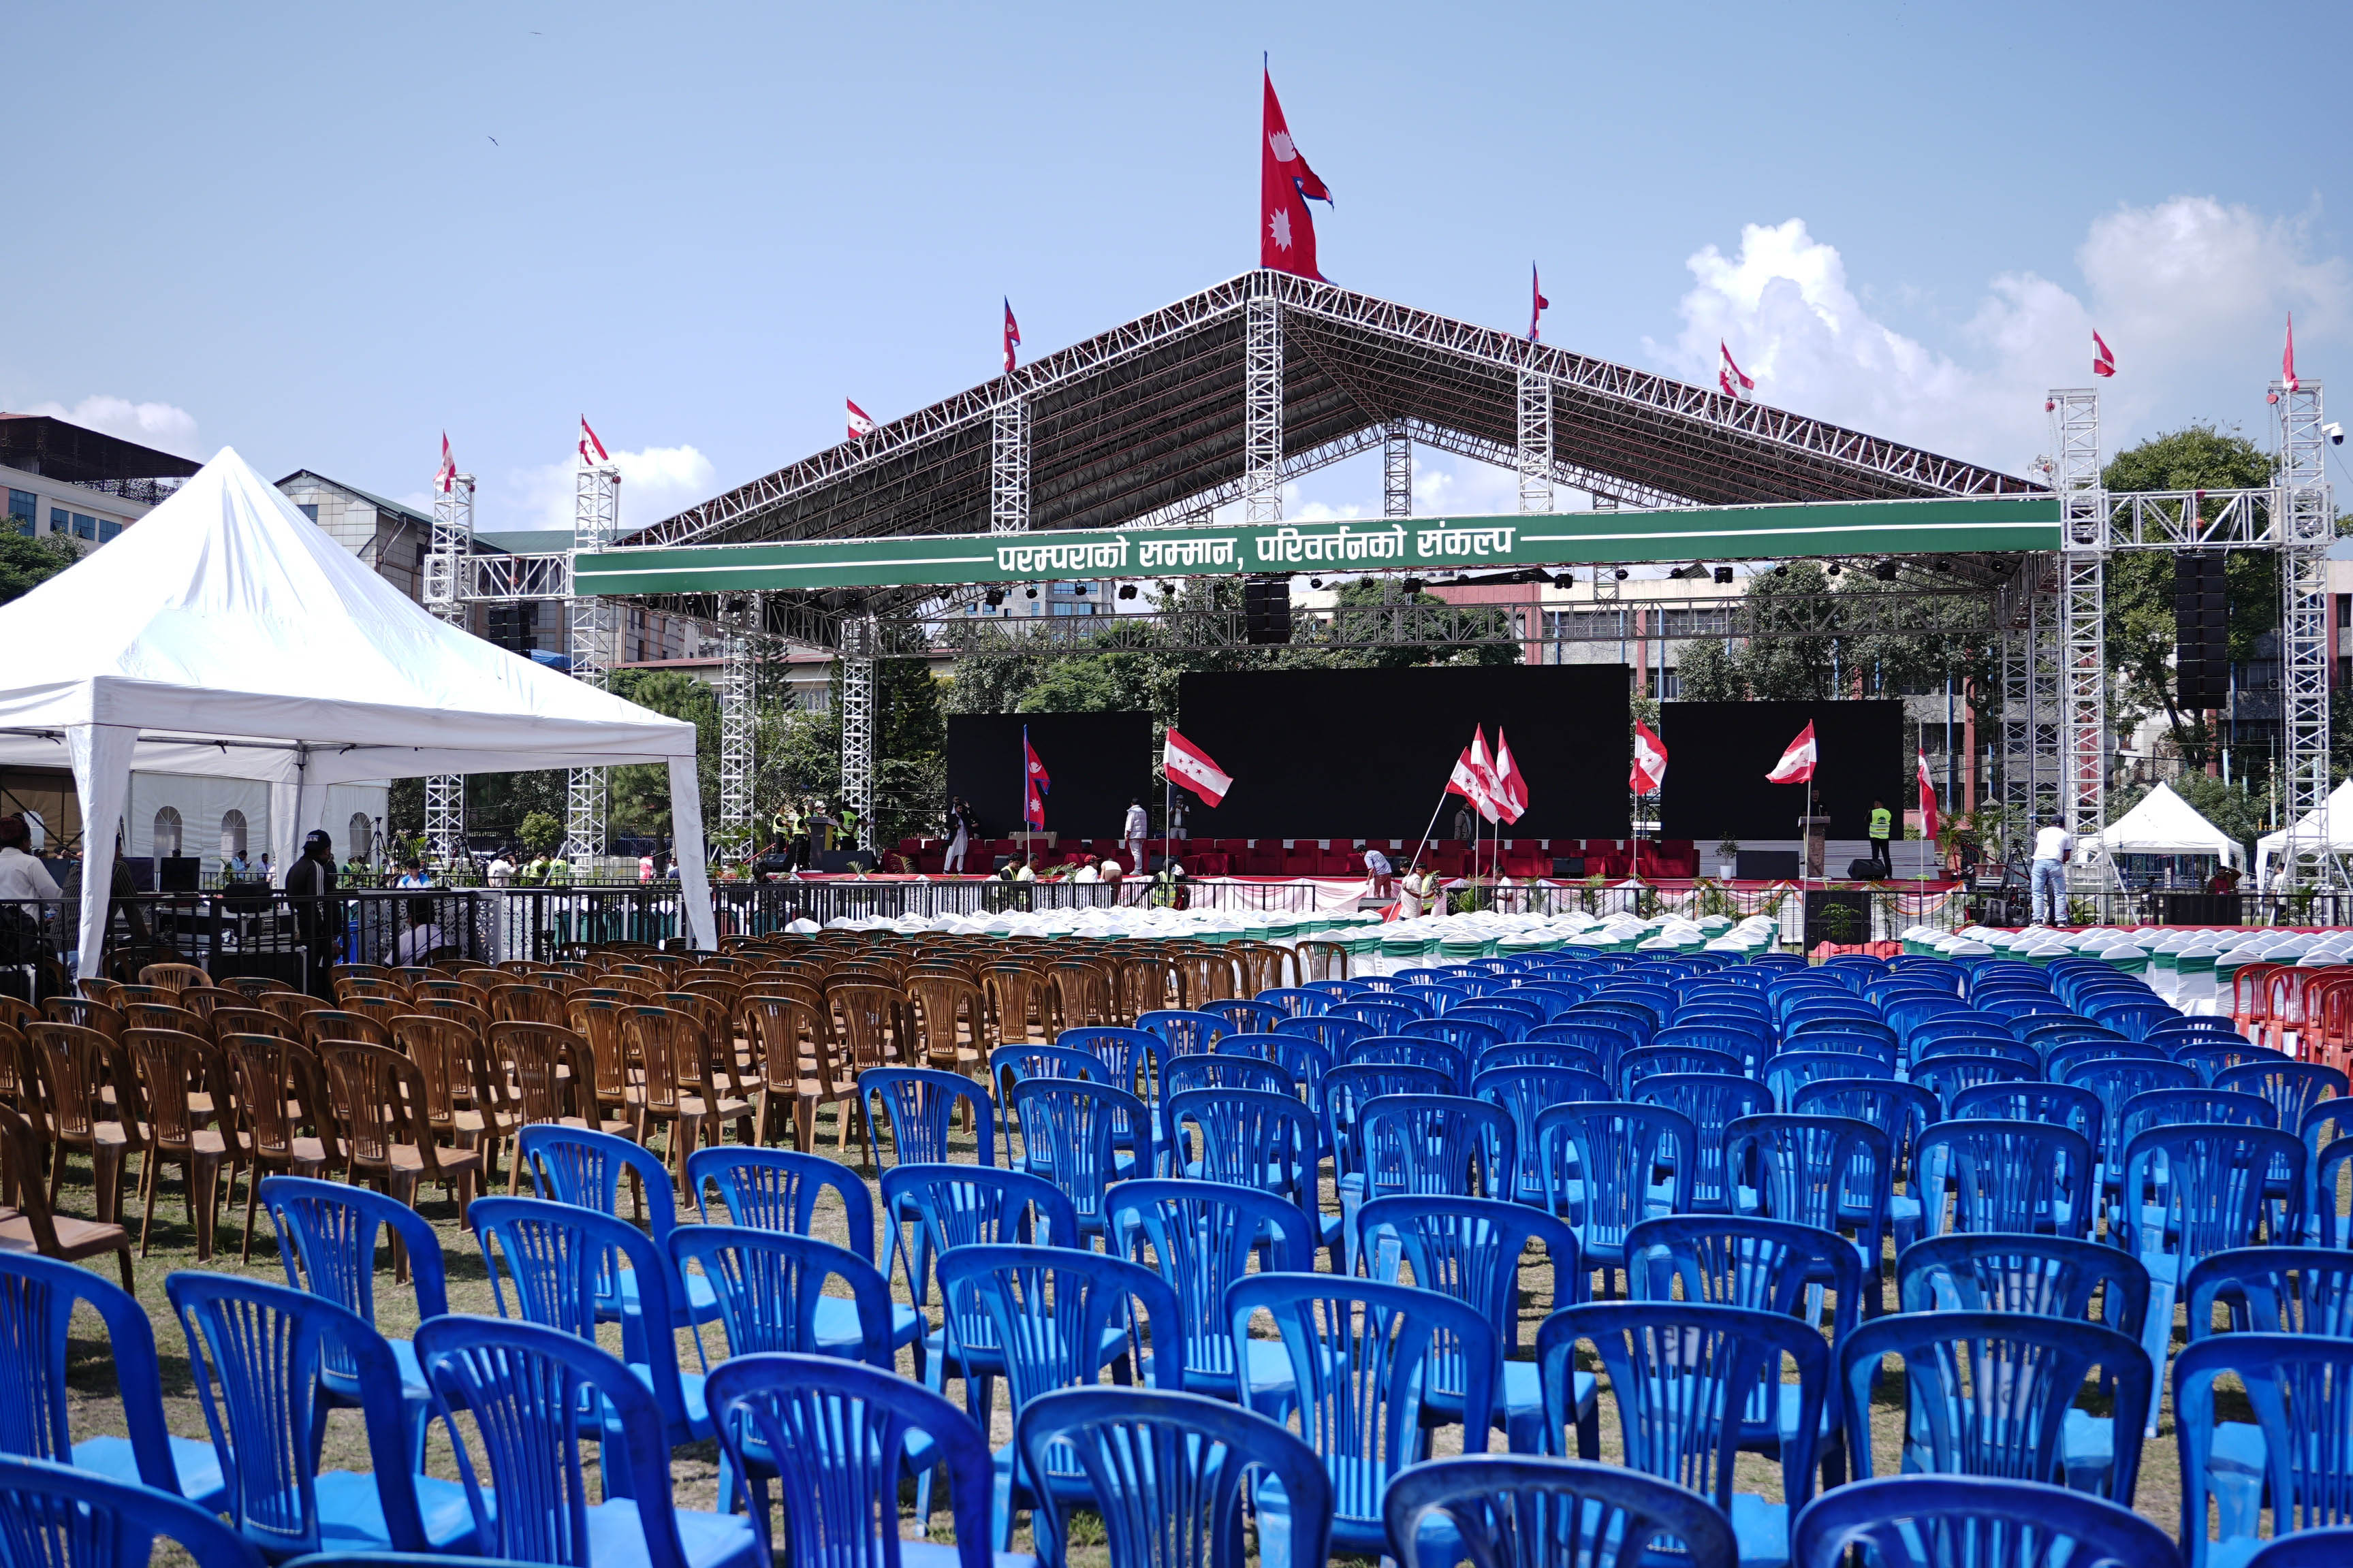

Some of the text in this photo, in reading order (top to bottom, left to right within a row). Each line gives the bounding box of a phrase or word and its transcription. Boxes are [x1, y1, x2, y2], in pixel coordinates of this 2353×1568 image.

[997, 520, 1516, 573] परम्पराको सम्मान, परिवर्तनको संकल्प
